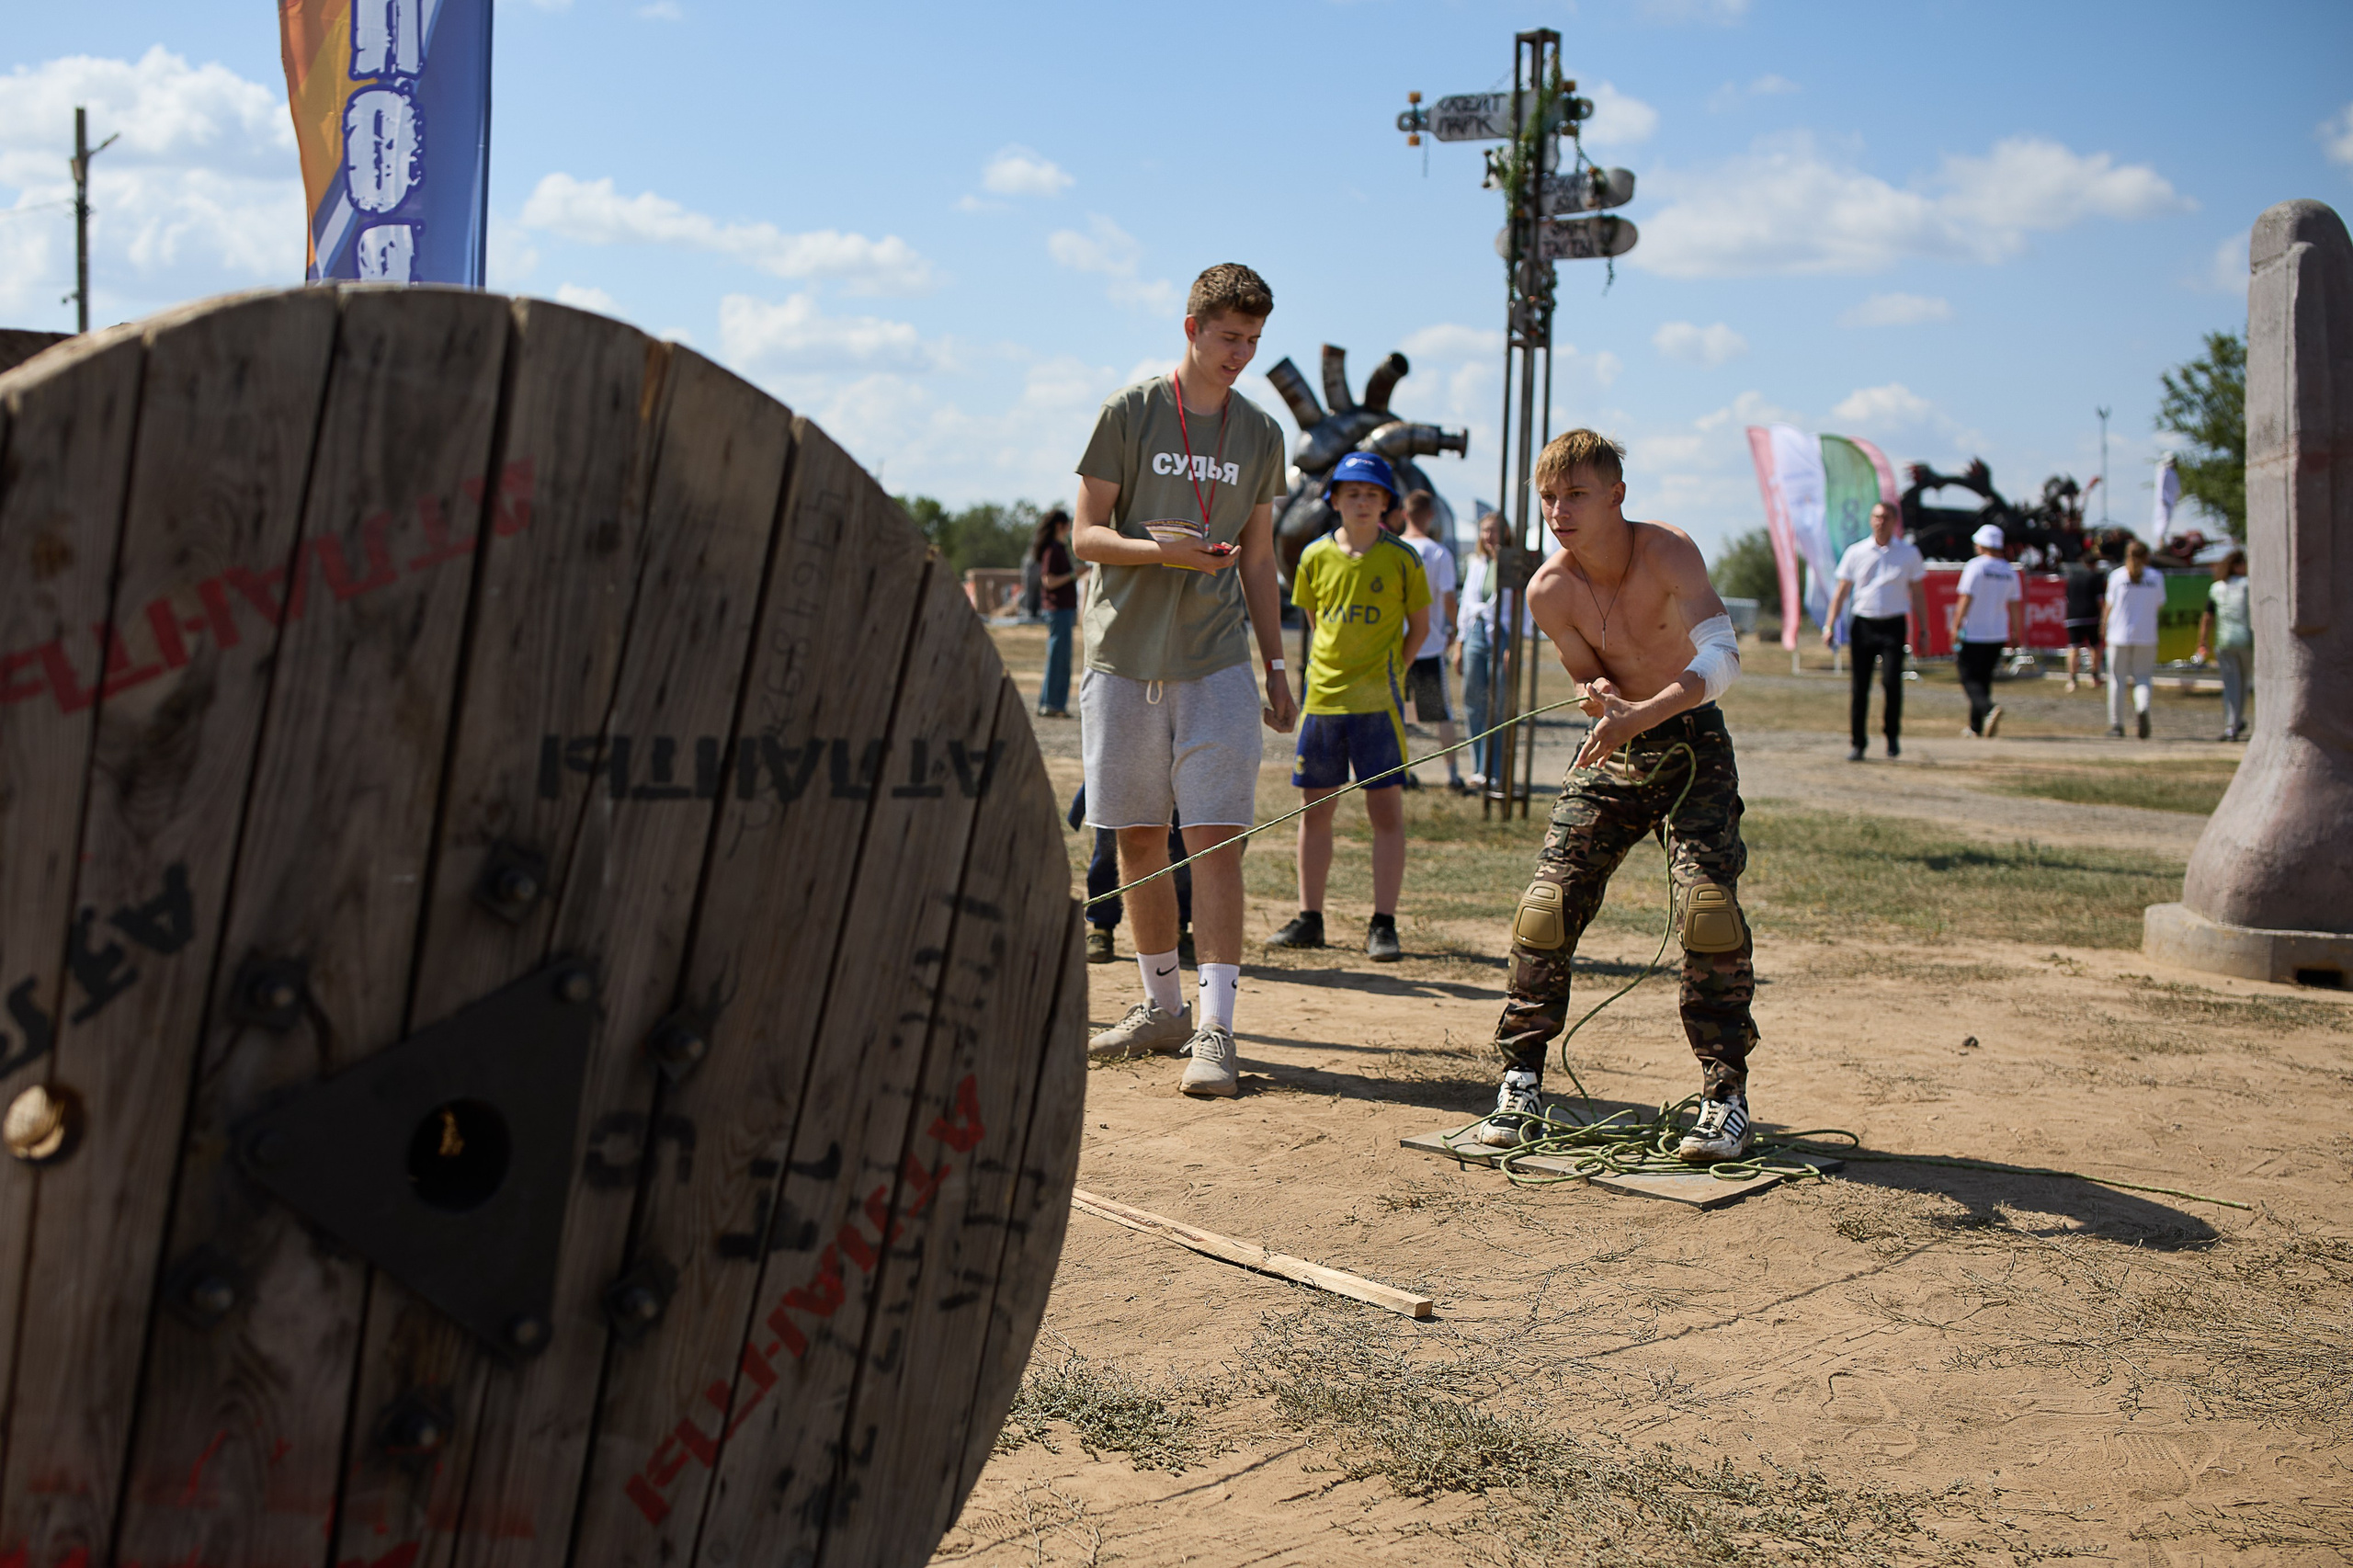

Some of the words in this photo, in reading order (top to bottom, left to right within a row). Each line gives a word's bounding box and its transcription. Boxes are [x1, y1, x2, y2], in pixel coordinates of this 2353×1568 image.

[1152, 452, 1240, 486] СУДЬЯ
[538, 736, 1006, 802] АТЛАНТЫ
[625, 1074, 985, 1526] АТЛАНТЫ
